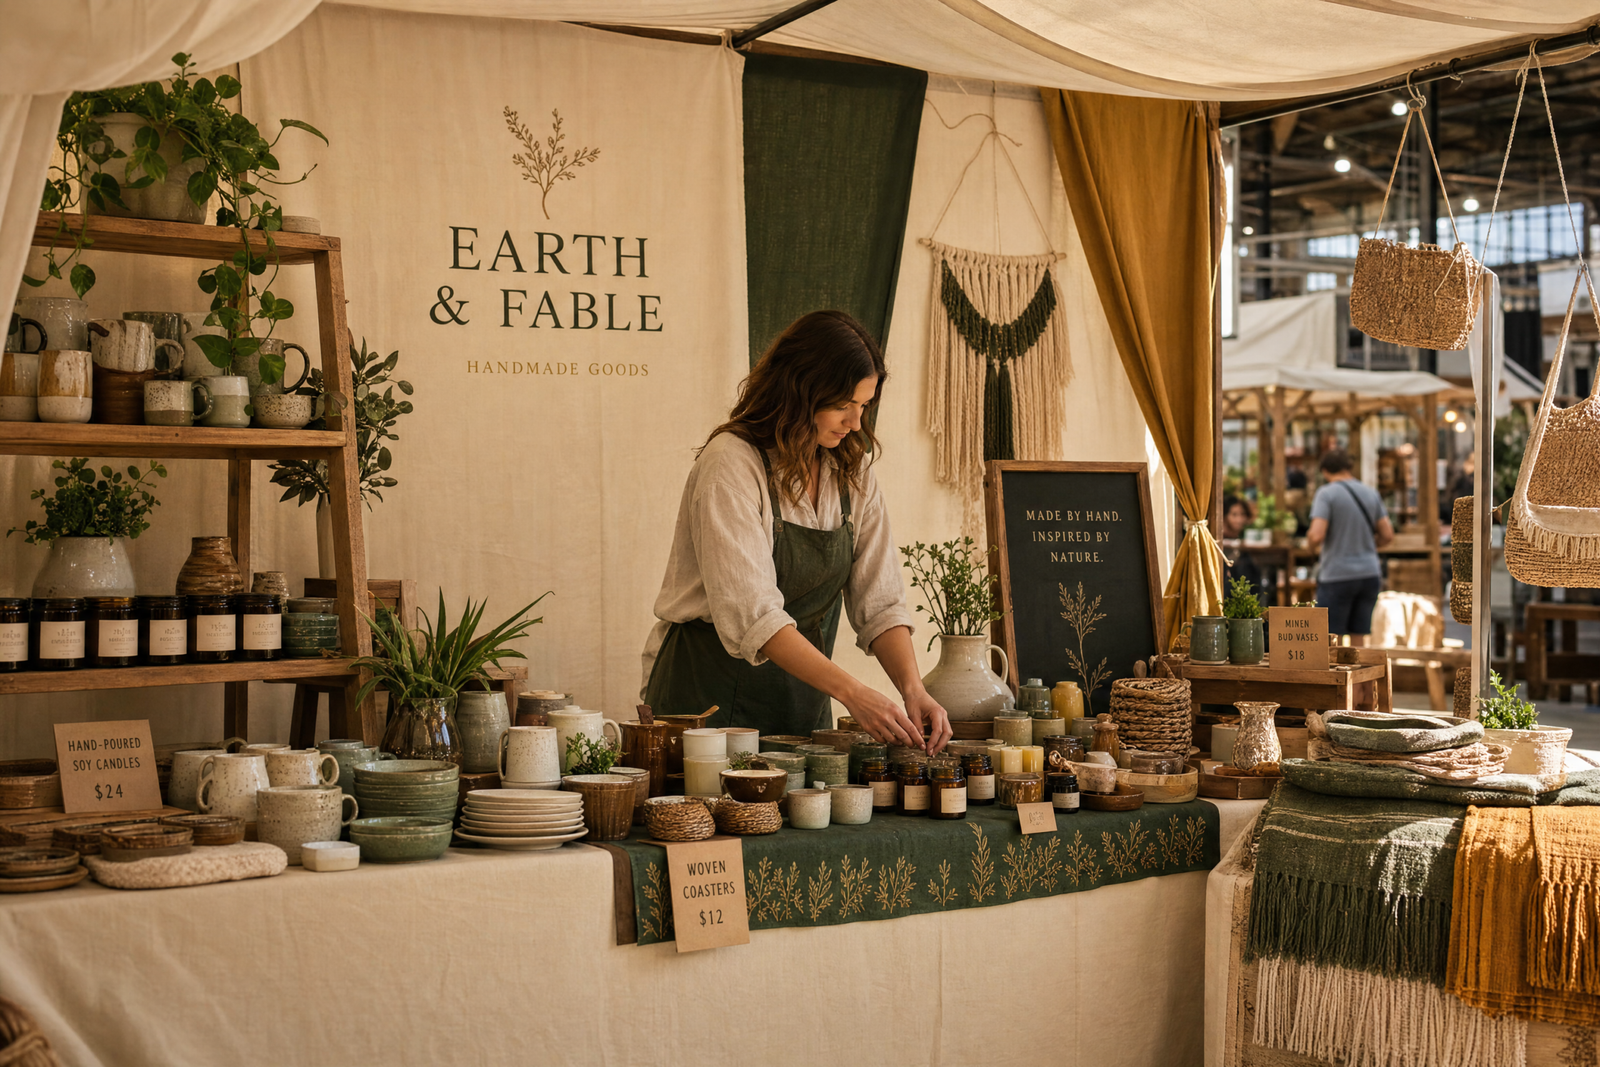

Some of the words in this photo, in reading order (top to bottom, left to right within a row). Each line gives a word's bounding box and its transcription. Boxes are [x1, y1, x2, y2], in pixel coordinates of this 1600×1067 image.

[448, 225, 649, 278] EARTH
[429, 285, 470, 326] &
[499, 288, 664, 332] FABLE
[467, 360, 579, 375] HANDMADE
[588, 362, 649, 376] GOODS
[1026, 510, 1062, 521] MADE
[1067, 510, 1081, 521] BY
[1086, 510, 1122, 522] HAND.
[1032, 531, 1091, 542] INSPIRED
[1096, 531, 1110, 542] BY
[1050, 551, 1104, 563] NATURE.
[1285, 619, 1310, 628] MINEN
[1278, 633, 1293, 641] BUD
[1296, 633, 1319, 641] VASES
[1288, 649, 1305, 660] $18
[68, 737, 141, 752] HAND-POURED
[73, 759, 91, 772] SOY
[96, 757, 141, 770] CANDLES
[94, 783, 123, 801] $24
[687, 860, 726, 876] WOVEN
[683, 881, 736, 899] COASTERS
[699, 909, 724, 928] $12
